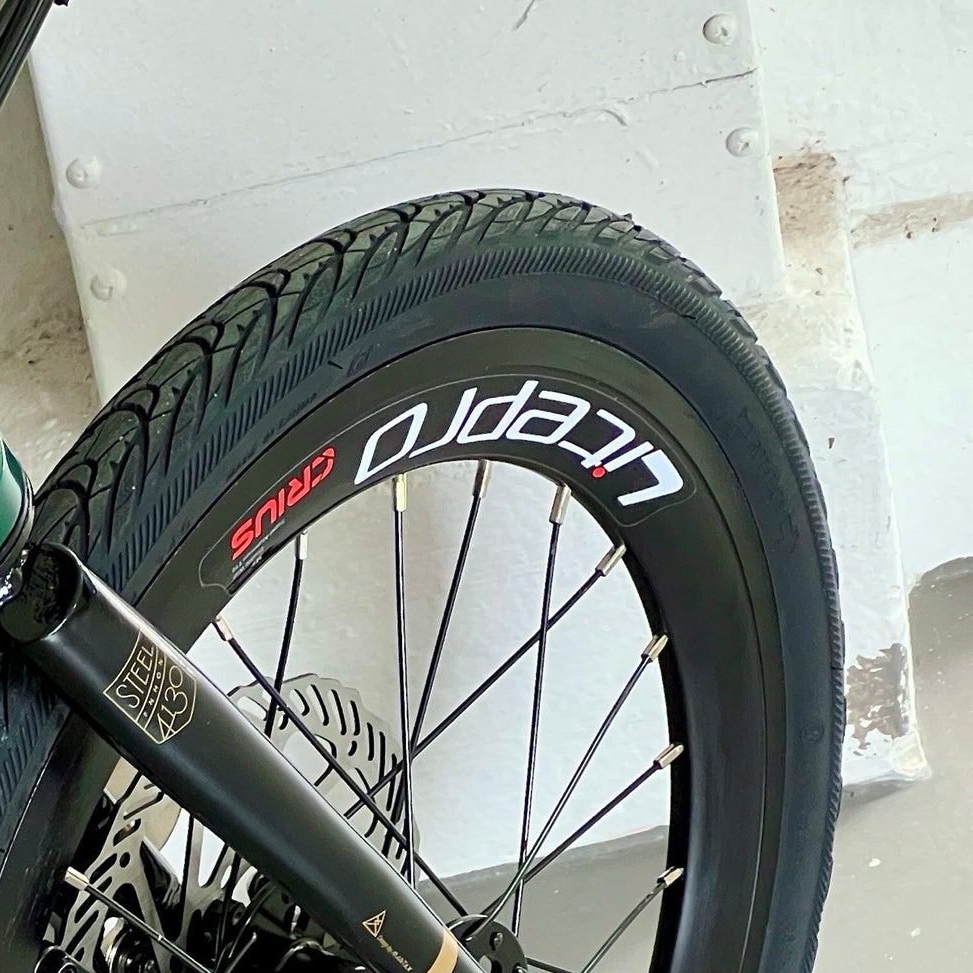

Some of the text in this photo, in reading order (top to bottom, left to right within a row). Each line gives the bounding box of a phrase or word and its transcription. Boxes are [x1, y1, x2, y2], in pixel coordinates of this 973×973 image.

[354, 380, 684, 506] Litepro
[229, 446, 336, 561] CRIUS
[115, 645, 155, 709] STEEL
[157, 665, 188, 740] 4130
